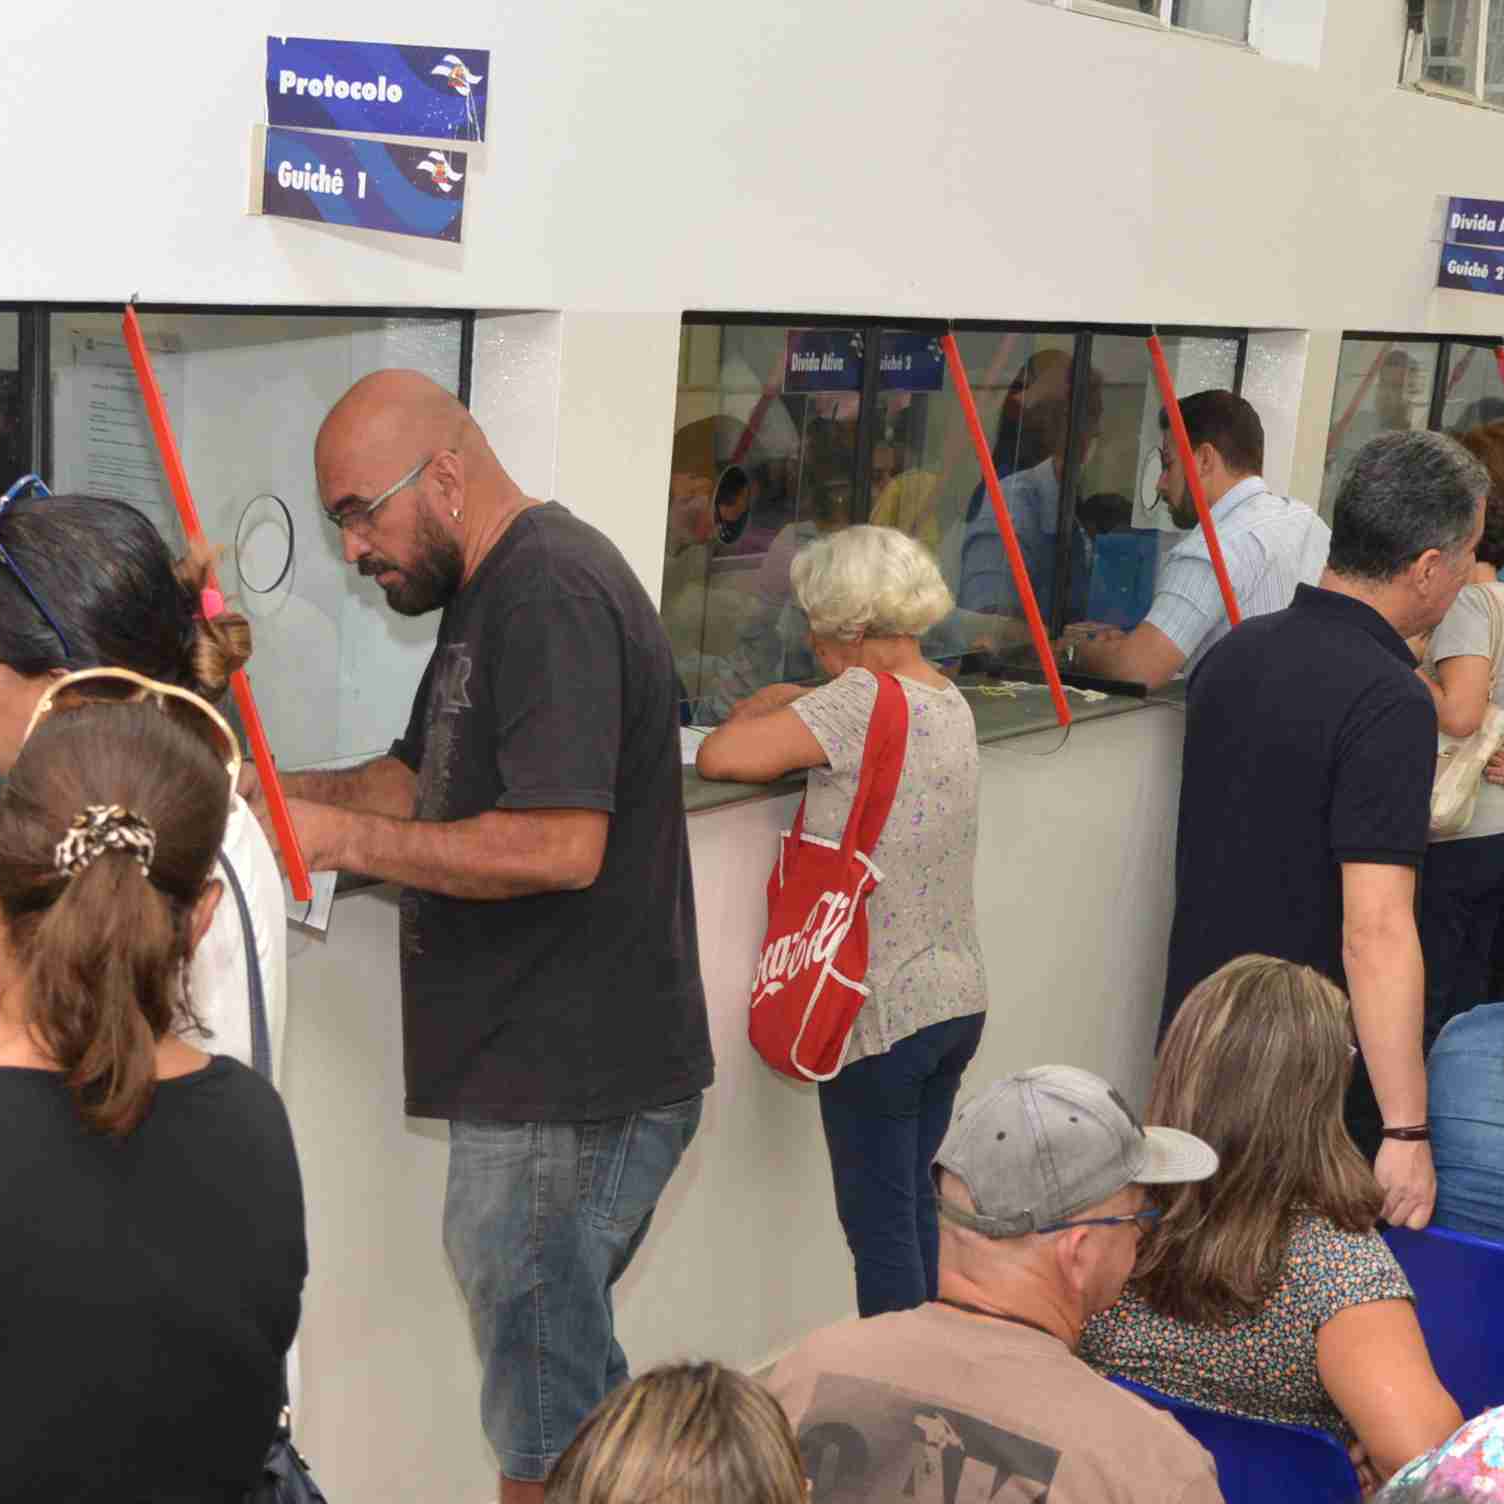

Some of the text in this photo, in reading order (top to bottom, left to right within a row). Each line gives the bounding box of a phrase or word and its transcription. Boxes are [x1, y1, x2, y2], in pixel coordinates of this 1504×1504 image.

[279, 69, 403, 103] Protocolo
[278, 160, 368, 199] Guichê 1
[1447, 259, 1504, 280] Guichê 2
